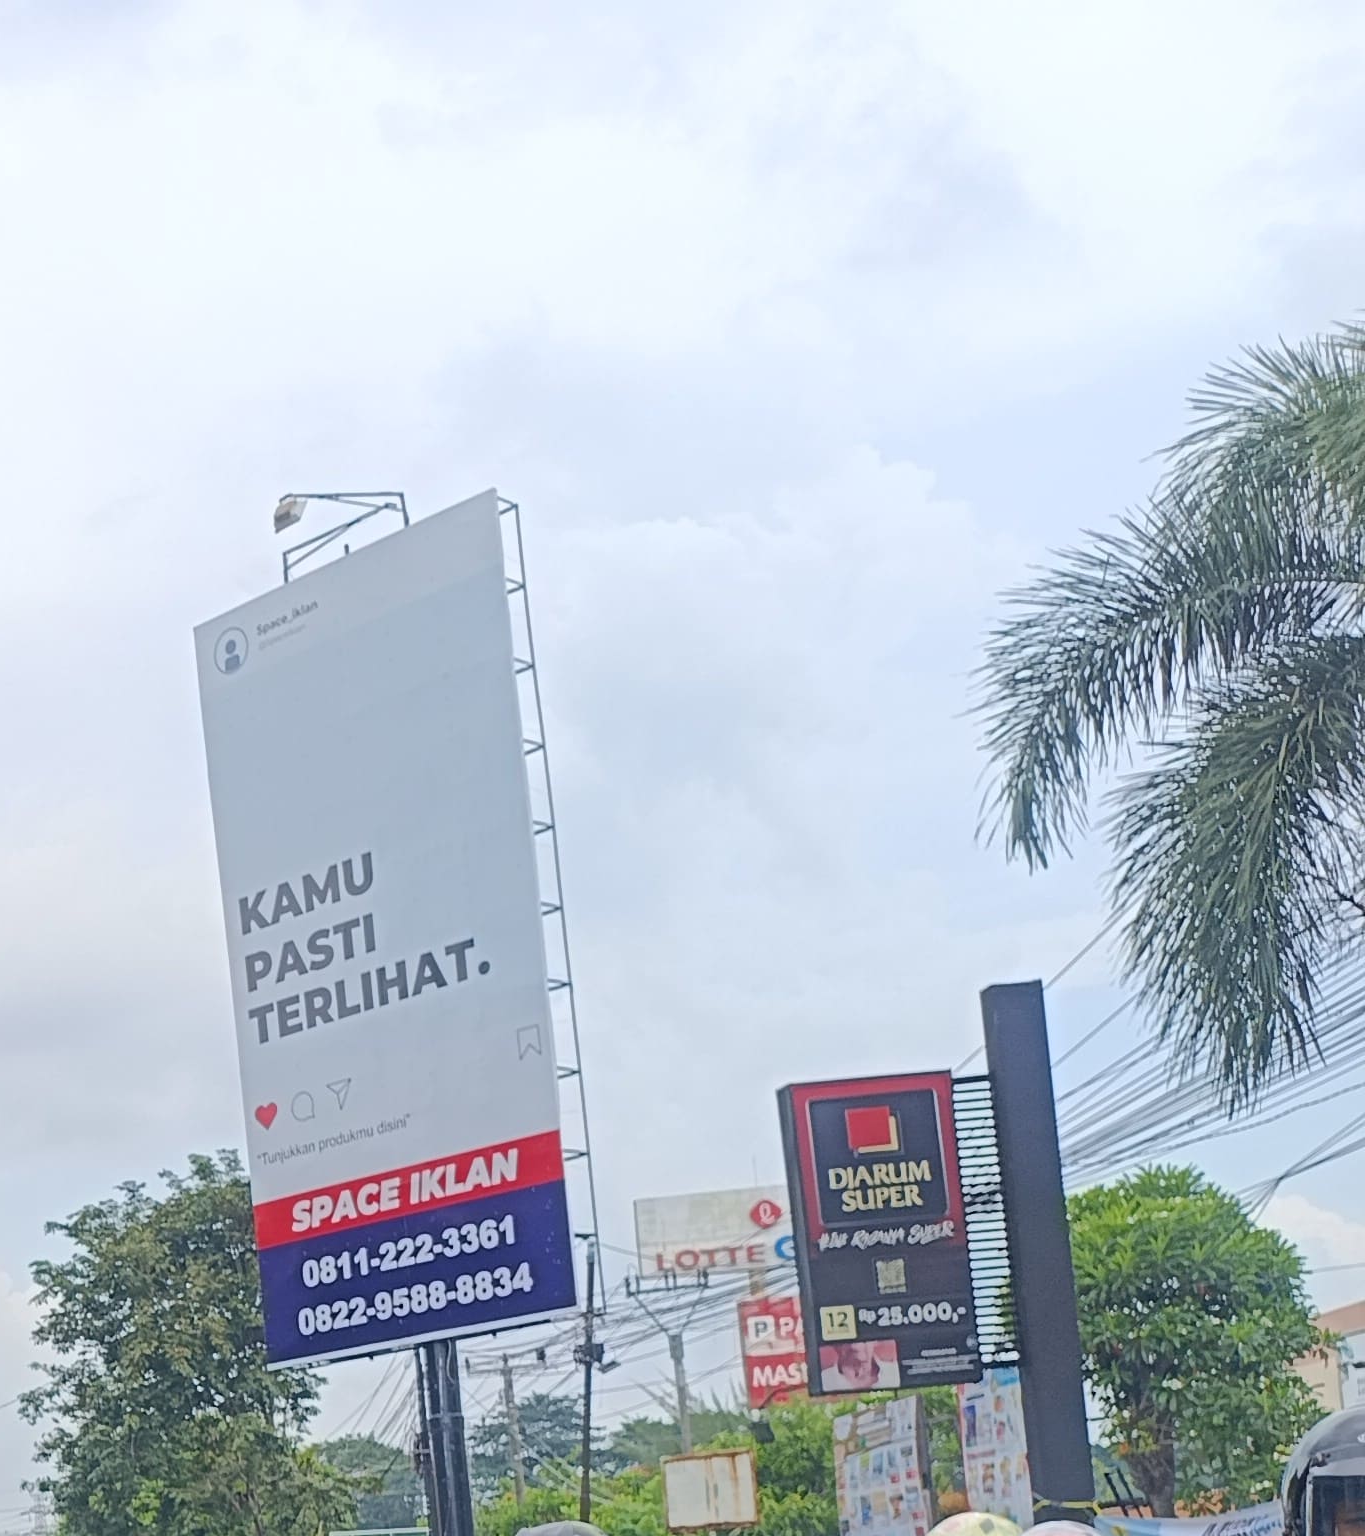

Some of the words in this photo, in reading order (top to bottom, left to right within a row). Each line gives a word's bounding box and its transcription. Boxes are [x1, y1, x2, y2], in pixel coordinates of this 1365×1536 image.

[239, 852, 374, 935] KAMU
[245, 913, 376, 992] PASTI
[248, 938, 491, 1044] TERLIHAT.
[319, 1126, 374, 1151] produkmu
[828, 1159, 932, 1190] DJARUM
[291, 1177, 400, 1232] SPACE
[410, 1148, 518, 1204] IKLAN
[842, 1185, 923, 1212] SUPER
[302, 1214, 516, 1288] 0811-222-3361
[656, 1243, 765, 1270] LOTTE
[298, 1262, 534, 1336] 0822-9588-8834
[826, 1311, 849, 1328] 12
